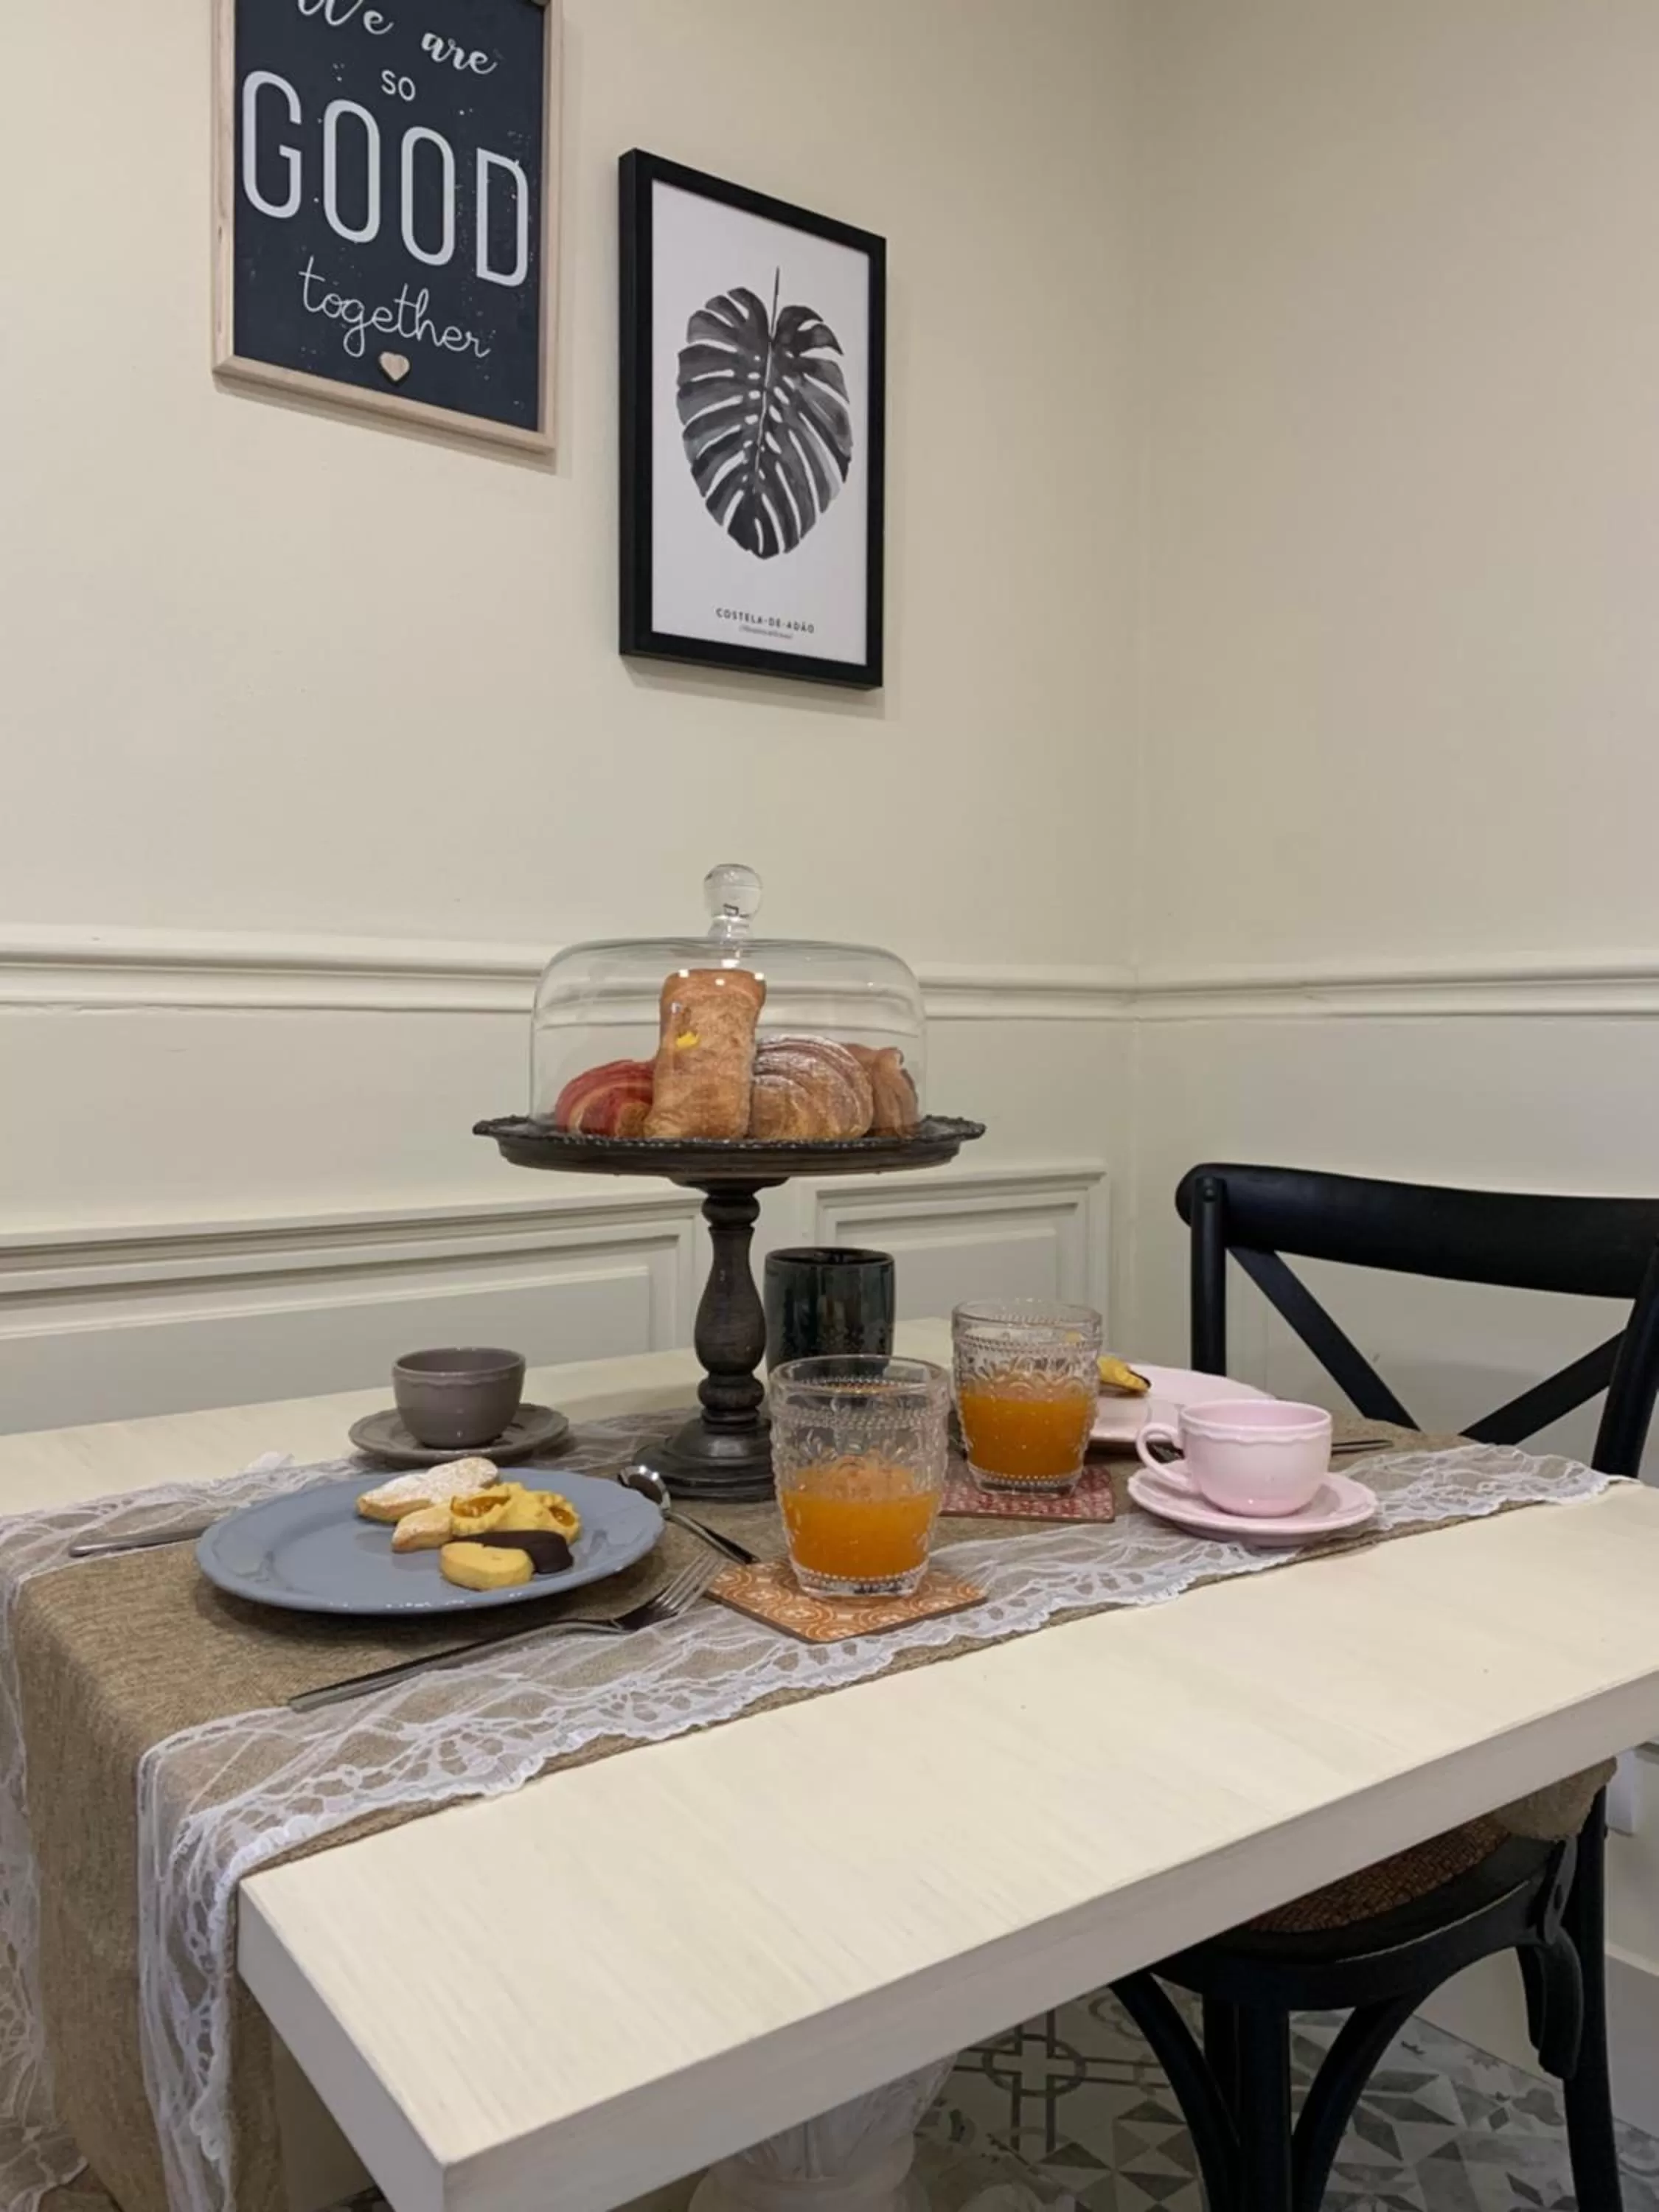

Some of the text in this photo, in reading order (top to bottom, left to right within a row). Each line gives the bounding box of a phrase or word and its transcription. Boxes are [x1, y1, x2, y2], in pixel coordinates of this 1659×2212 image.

[421, 32, 497, 74] are
[242, 70, 529, 287] GOOD
[298, 256, 491, 358] together
